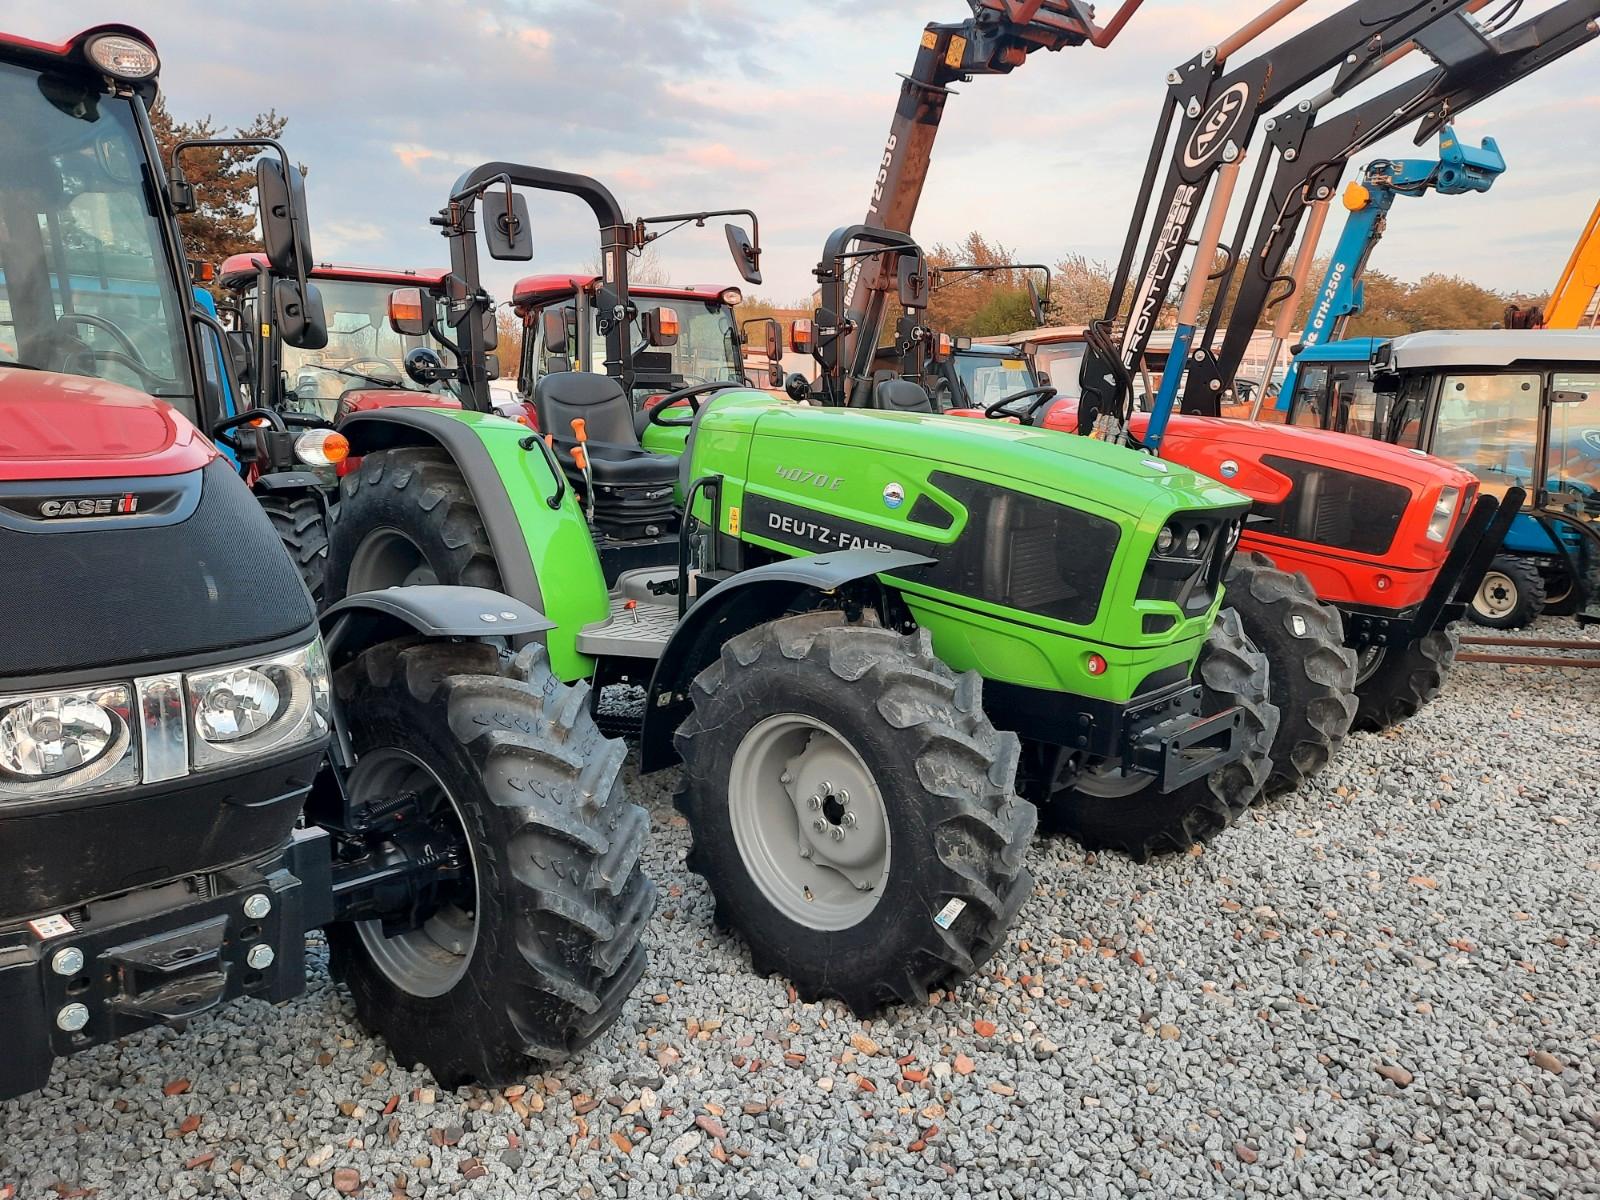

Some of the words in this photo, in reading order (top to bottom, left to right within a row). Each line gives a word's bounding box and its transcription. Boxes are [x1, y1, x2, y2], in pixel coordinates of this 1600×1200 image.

[1147, 187, 1184, 279] INDUSTRIE
[1123, 185, 1198, 370] FRONTLADER
[1313, 262, 1345, 329] GTH-2506
[41, 499, 113, 517] CASE
[775, 463, 829, 488] 4070
[829, 476, 846, 491] E
